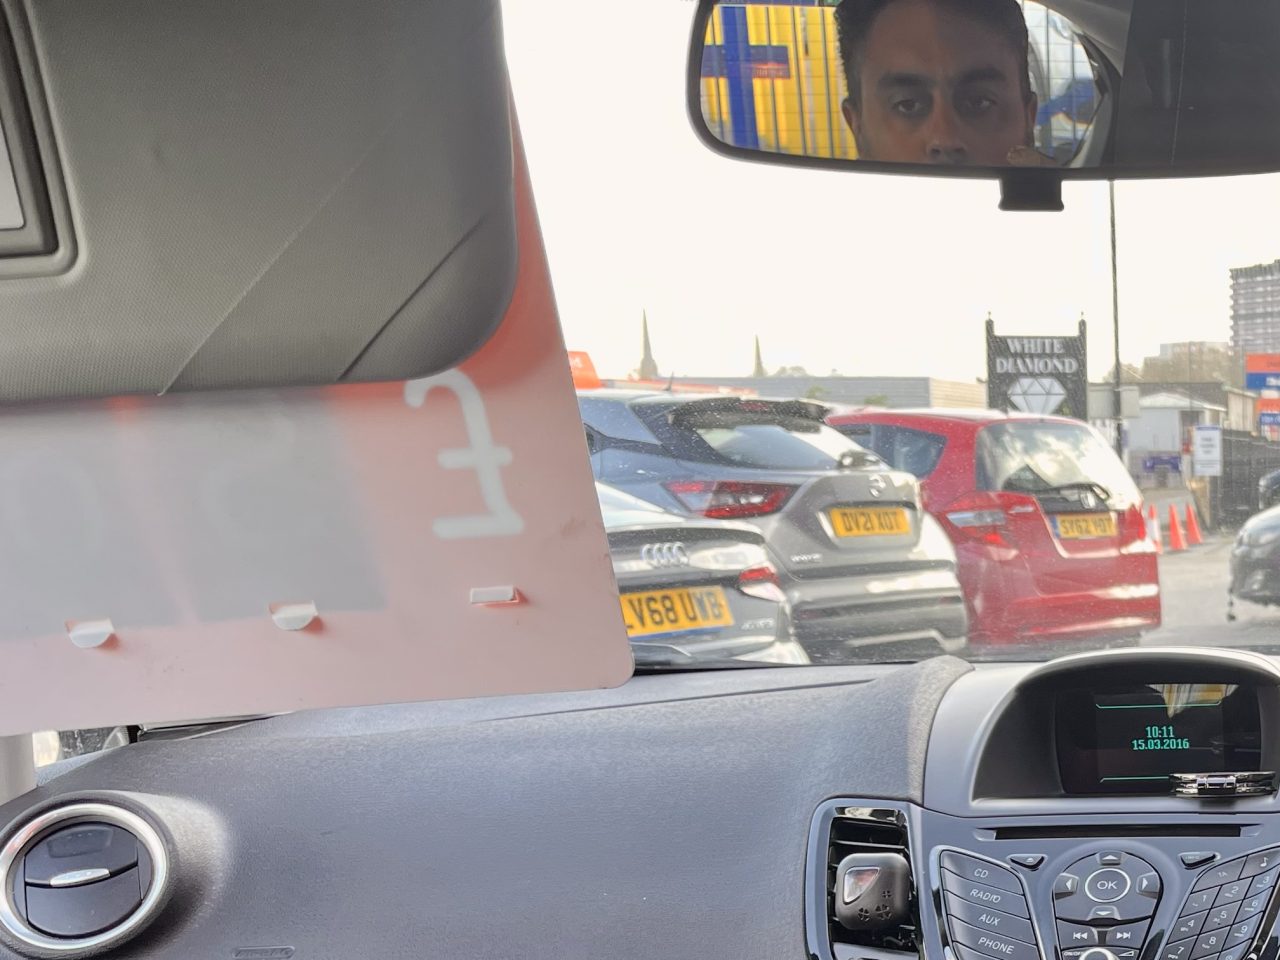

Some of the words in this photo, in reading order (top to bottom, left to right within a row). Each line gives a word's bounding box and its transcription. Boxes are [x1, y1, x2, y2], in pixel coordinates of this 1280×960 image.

[1006, 338, 1064, 354] WHITE
[995, 357, 1078, 374] DIAMOND
[1145, 726, 1175, 738] 10:11
[1132, 739, 1190, 750] 15.03.2016
[974, 868, 989, 879] CD
[1097, 880, 1118, 890] OK
[1263, 876, 1270, 884] 3
[1231, 885, 1239, 894] 2
[970, 888, 1001, 904] RADIO
[1202, 894, 1207, 902] 1
[1220, 910, 1227, 919] 5
[978, 913, 1001, 927] AUX
[1187, 919, 1195, 928] 4
[1241, 925, 1248, 934] 9
[1208, 936, 1217, 945] 8
[978, 937, 1015, 955] PHONE
[1178, 946, 1185, 954] 7
